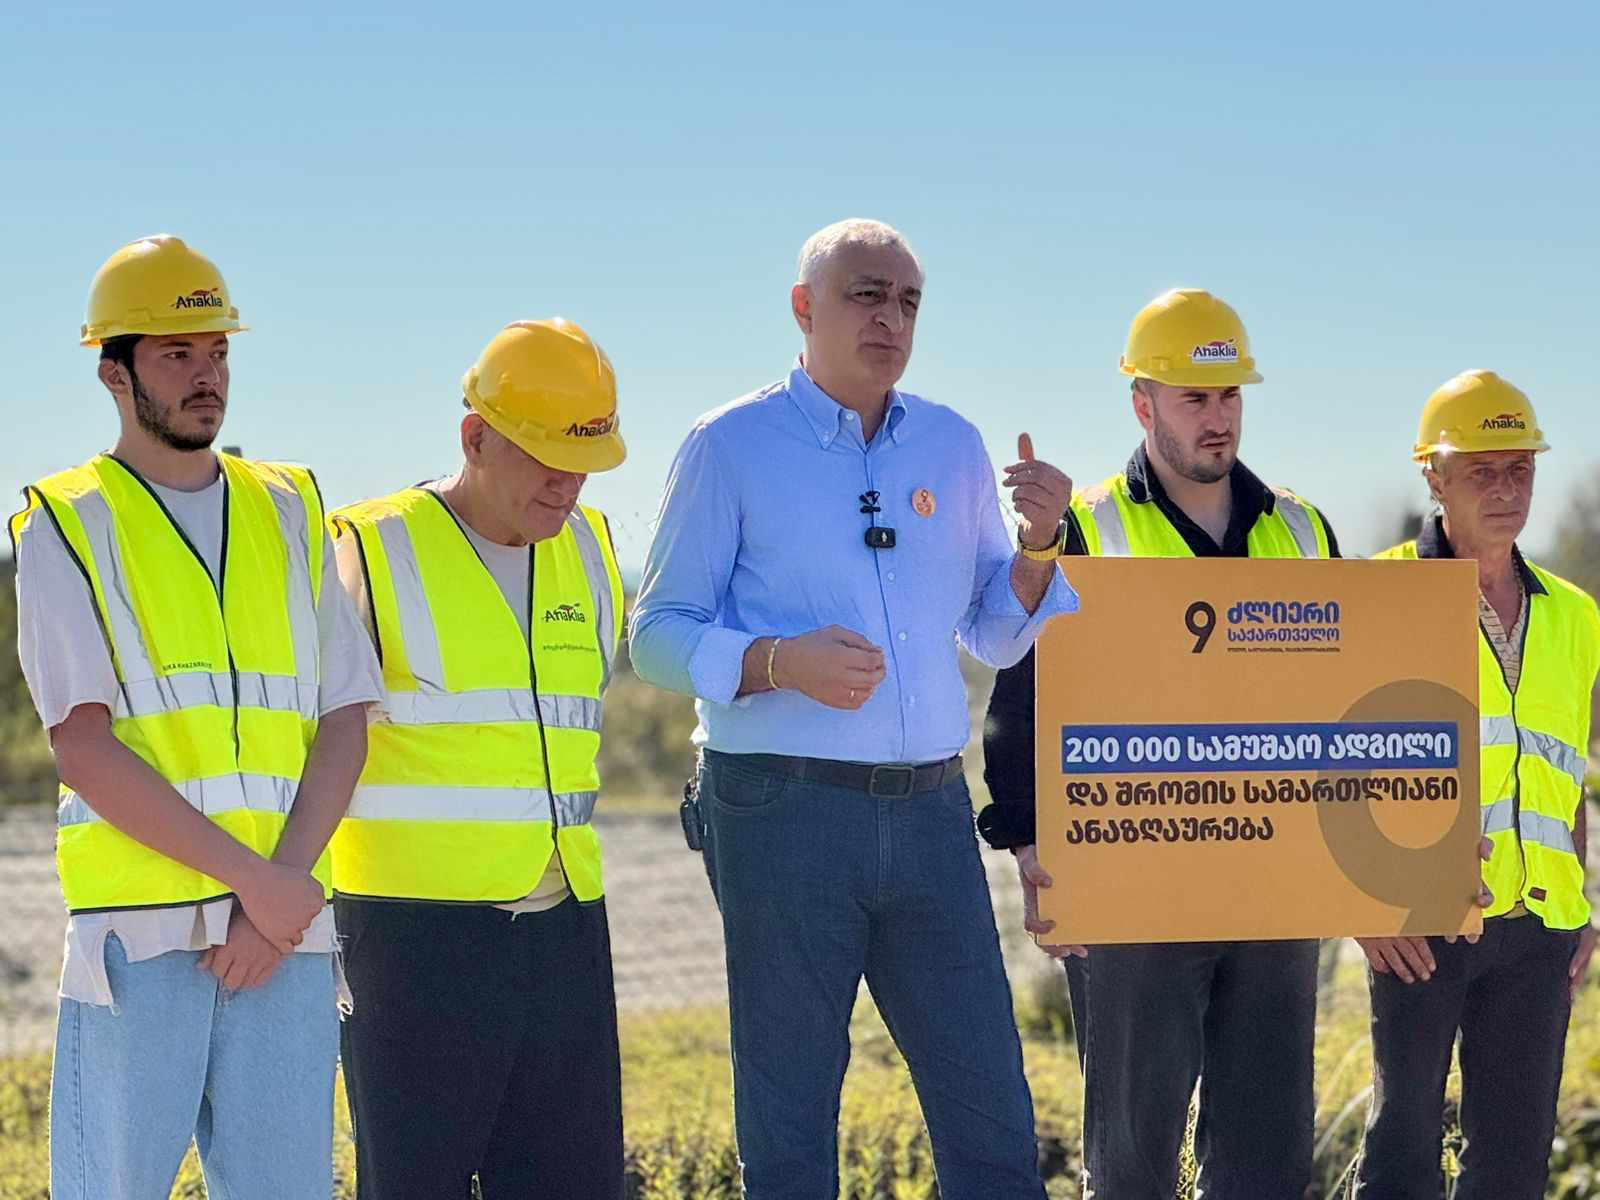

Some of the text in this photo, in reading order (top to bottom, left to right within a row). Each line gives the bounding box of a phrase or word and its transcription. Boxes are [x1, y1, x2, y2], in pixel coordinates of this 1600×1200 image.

[176, 293, 223, 309] Anaklia
[1193, 344, 1237, 357] Anaklia
[1482, 418, 1526, 430] Anaklia
[545, 608, 586, 623] Anaklia
[1228, 601, 1340, 624] ძლიერი
[1185, 601, 1216, 653] 9
[1228, 628, 1340, 642] საქართველო
[1066, 732, 1451, 763] 200 000 სამუშაო ადგილი
[1066, 776, 1458, 807] და შრომის სამართლიანი
[1066, 816, 1274, 844] ანაზღაურება
